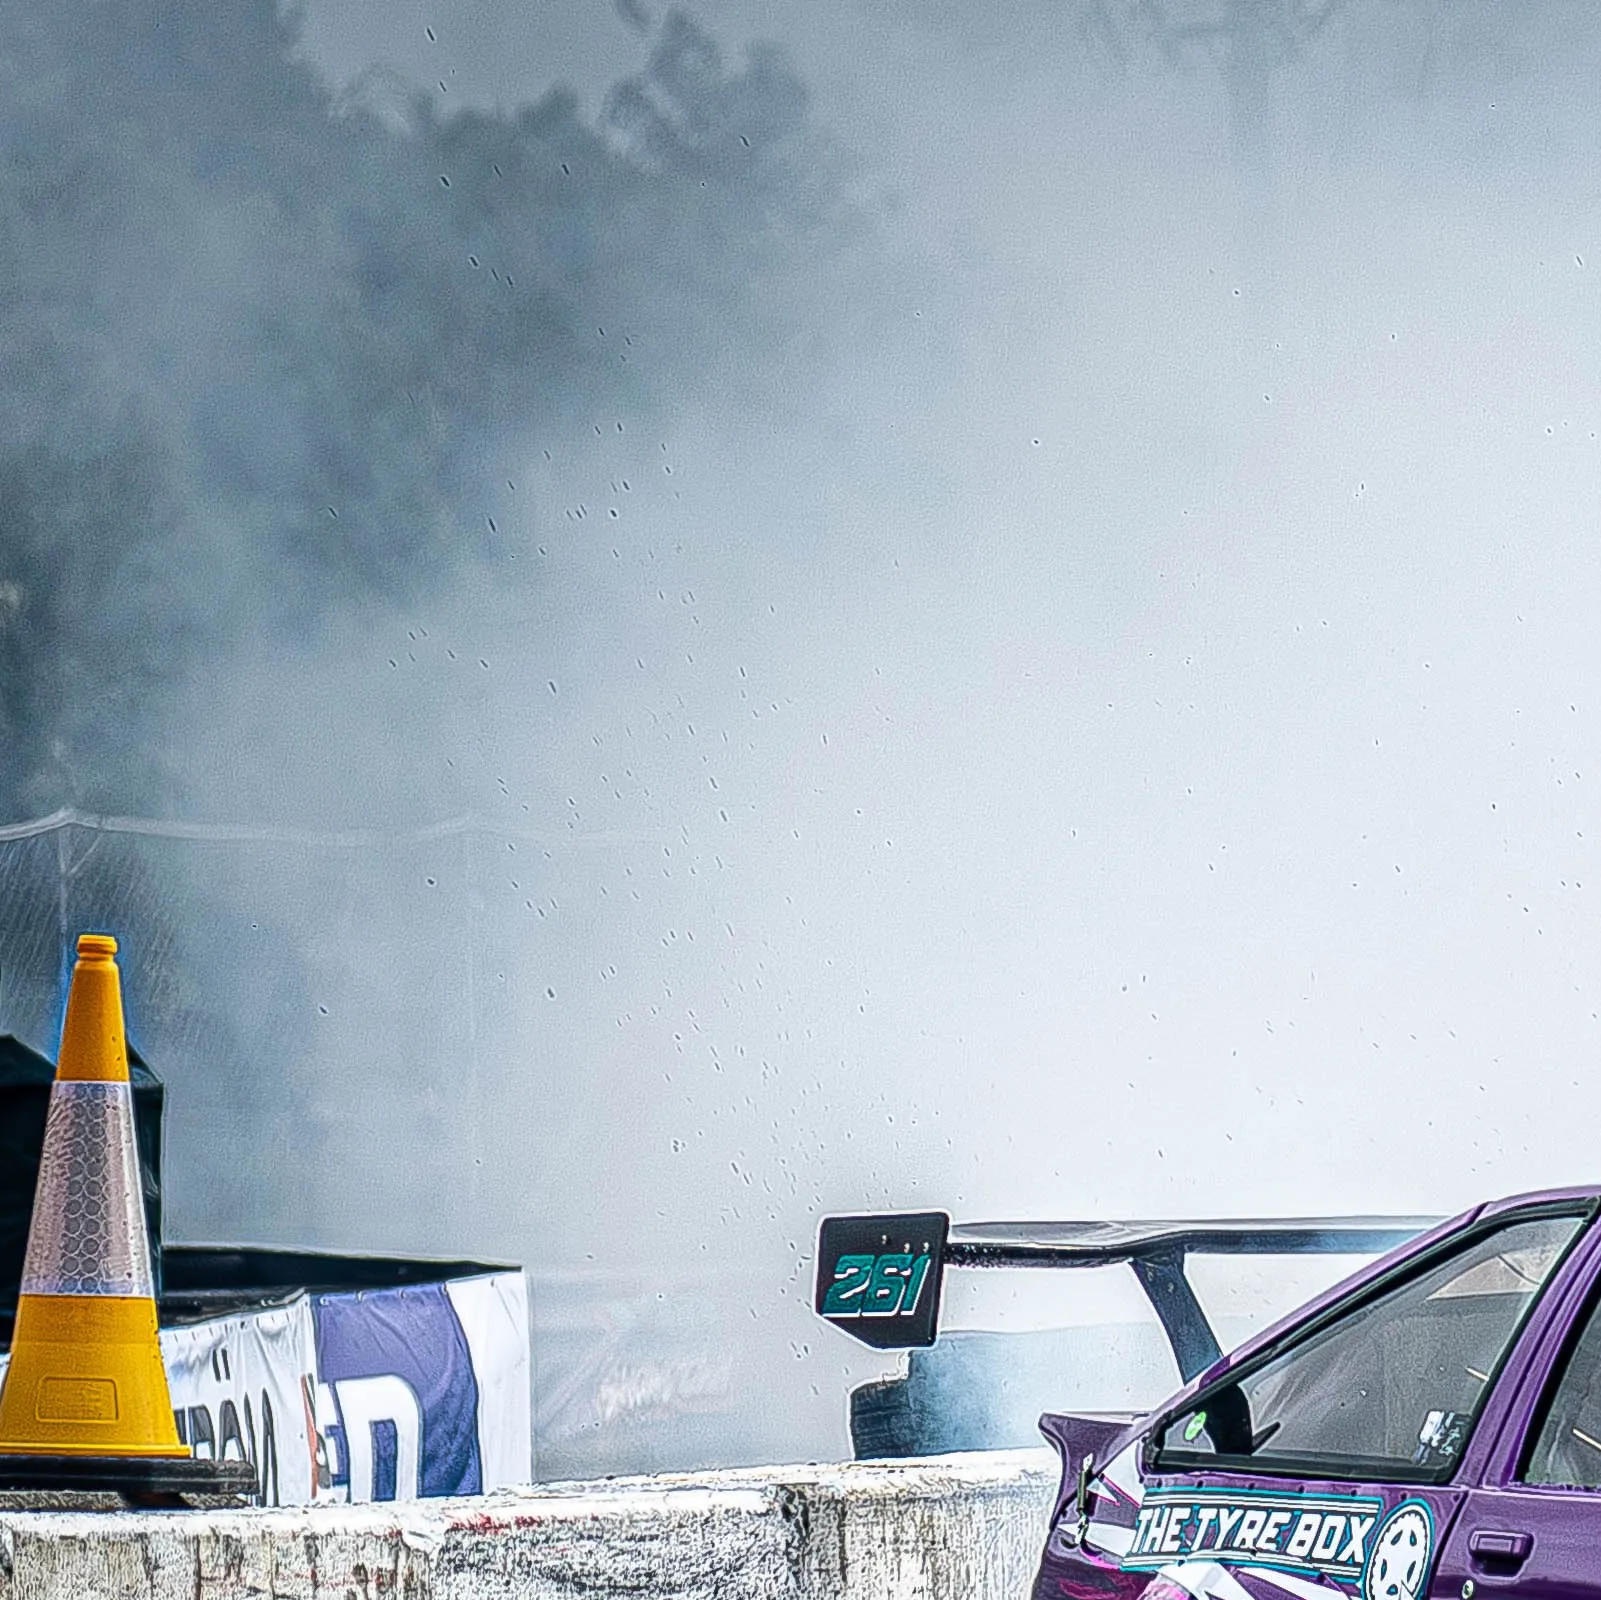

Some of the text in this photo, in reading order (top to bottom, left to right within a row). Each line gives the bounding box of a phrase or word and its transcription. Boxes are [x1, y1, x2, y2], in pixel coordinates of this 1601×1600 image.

[823, 1254, 930, 1317] 261
[1132, 1505, 1374, 1562] THE TYRE BOX
